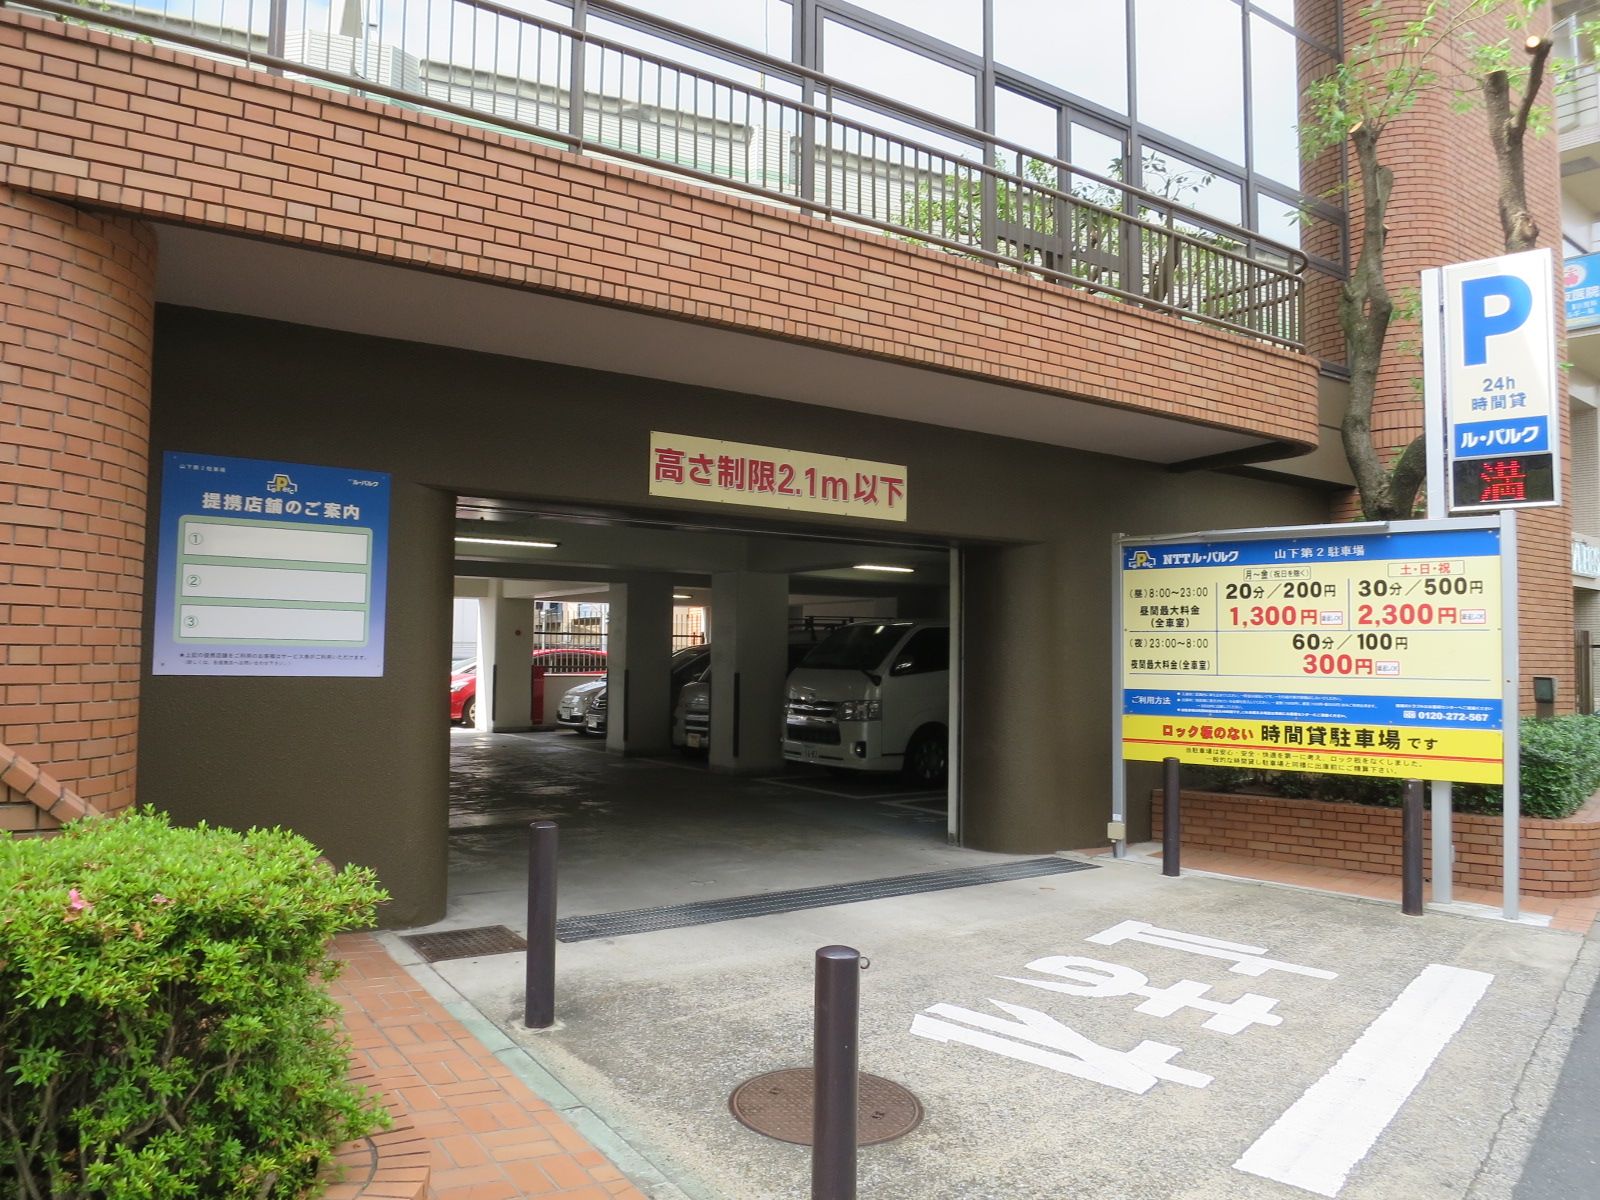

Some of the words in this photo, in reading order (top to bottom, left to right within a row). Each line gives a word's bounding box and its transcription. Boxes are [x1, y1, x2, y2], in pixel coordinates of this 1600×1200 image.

[1461, 274, 1533, 367] P
[1482, 377, 1516, 392] 24h
[1471, 393, 1527, 411] 時間貸
[1460, 425, 1540, 448] ル・パルク
[654, 447, 905, 509] 高さ制限2.1m以下
[1479, 460, 1527, 502] 満
[202, 492, 361, 521] 提携店舗のご案内
[1163, 550, 1240, 565] NTTル・パルク
[1274, 545, 1365, 559] 山下第2駐車場
[1400, 562, 1451, 575] 土・日・祝
[1139, 605, 1200, 615] 昼間最大料金
[1230, 605, 1317, 628] 1,300円
[1357, 603, 1457, 628] 2,300円
[1150, 617, 1190, 628] (全車室)
[1303, 653, 1373, 675] 300円
[1132, 695, 1172, 705] ご利用方法
[1418, 711, 1489, 722] 0120-272-567
[1162, 724, 1254, 741] ロック板のない
[1261, 724, 1401, 750] 時間貸駐車場
[1407, 737, 1439, 750] です
[908, 918, 1340, 1096] 止まれ
